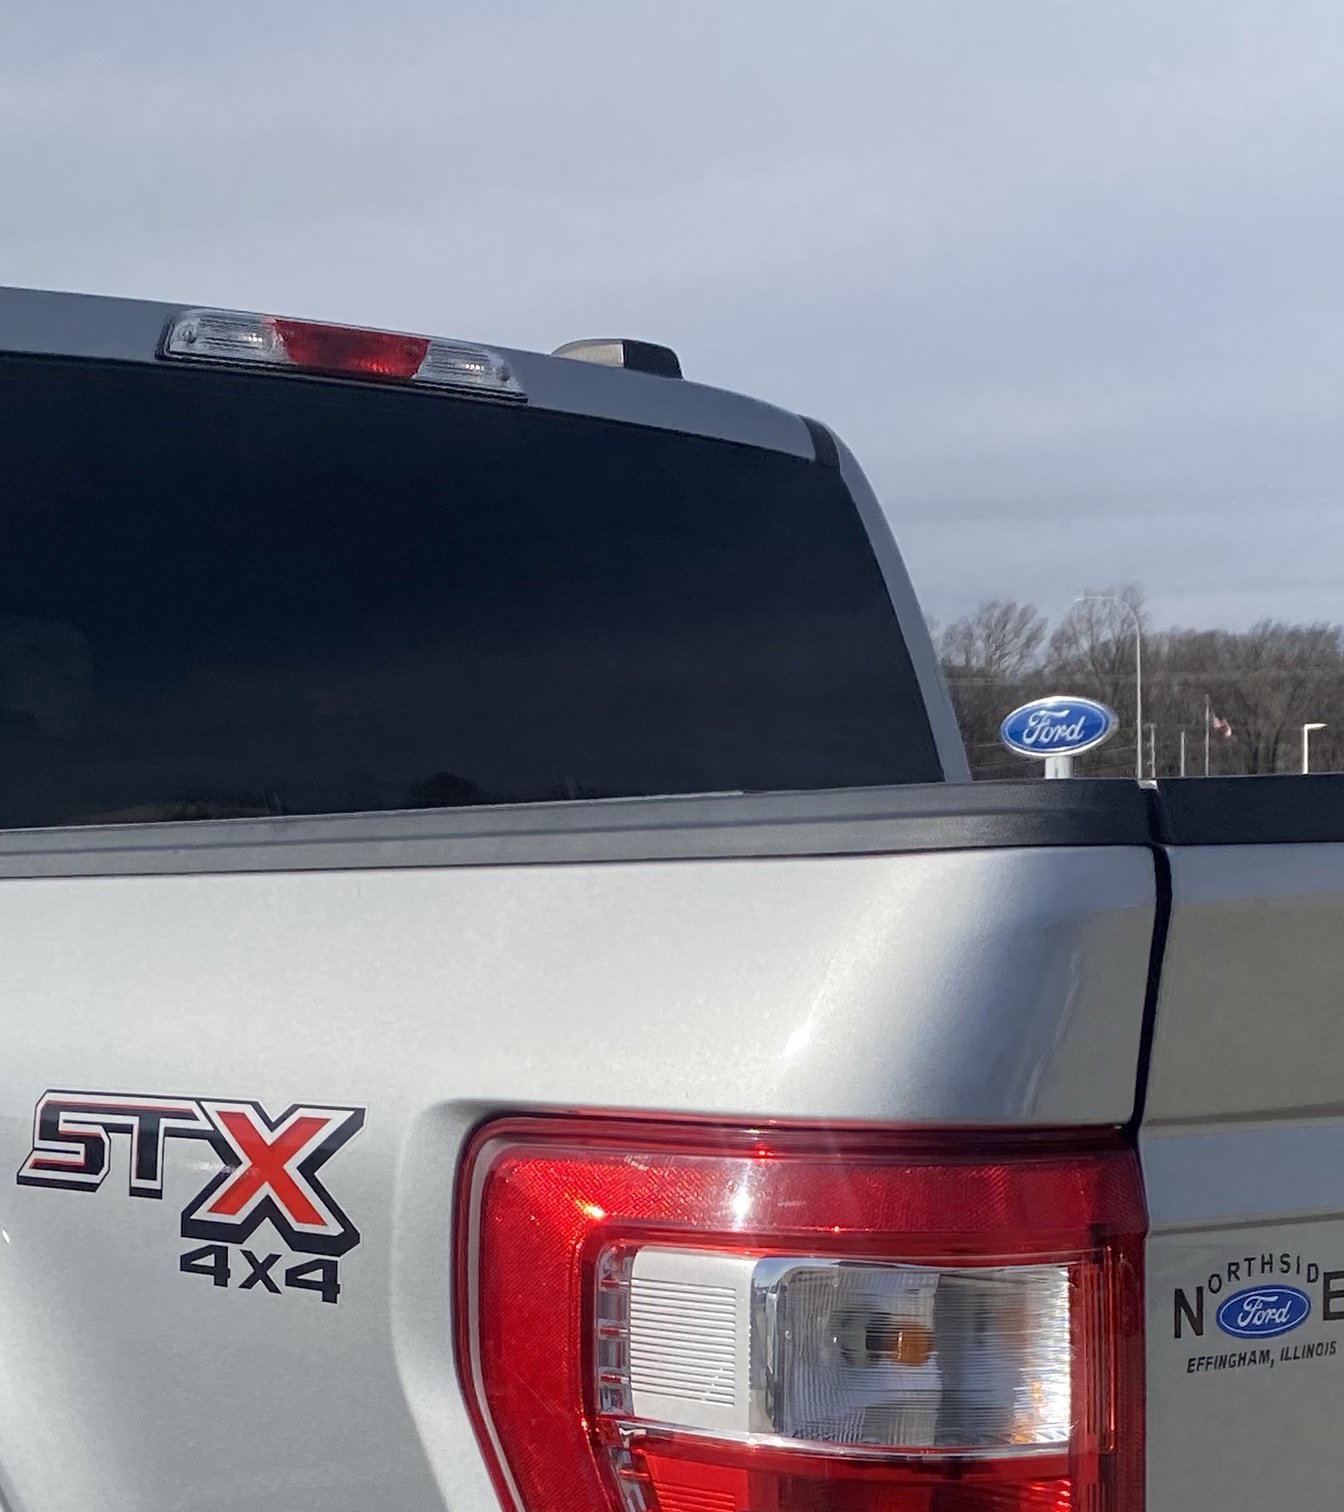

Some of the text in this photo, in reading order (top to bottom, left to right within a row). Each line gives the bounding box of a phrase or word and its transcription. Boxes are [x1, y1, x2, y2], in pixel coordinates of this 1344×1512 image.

[1023, 709, 1086, 745] Ford
[17, 1089, 366, 1256] STX
[1237, 1295, 1293, 1327] Ford
[1186, 1341, 1337, 1373] EFFINGHAM, ILLINOIS
